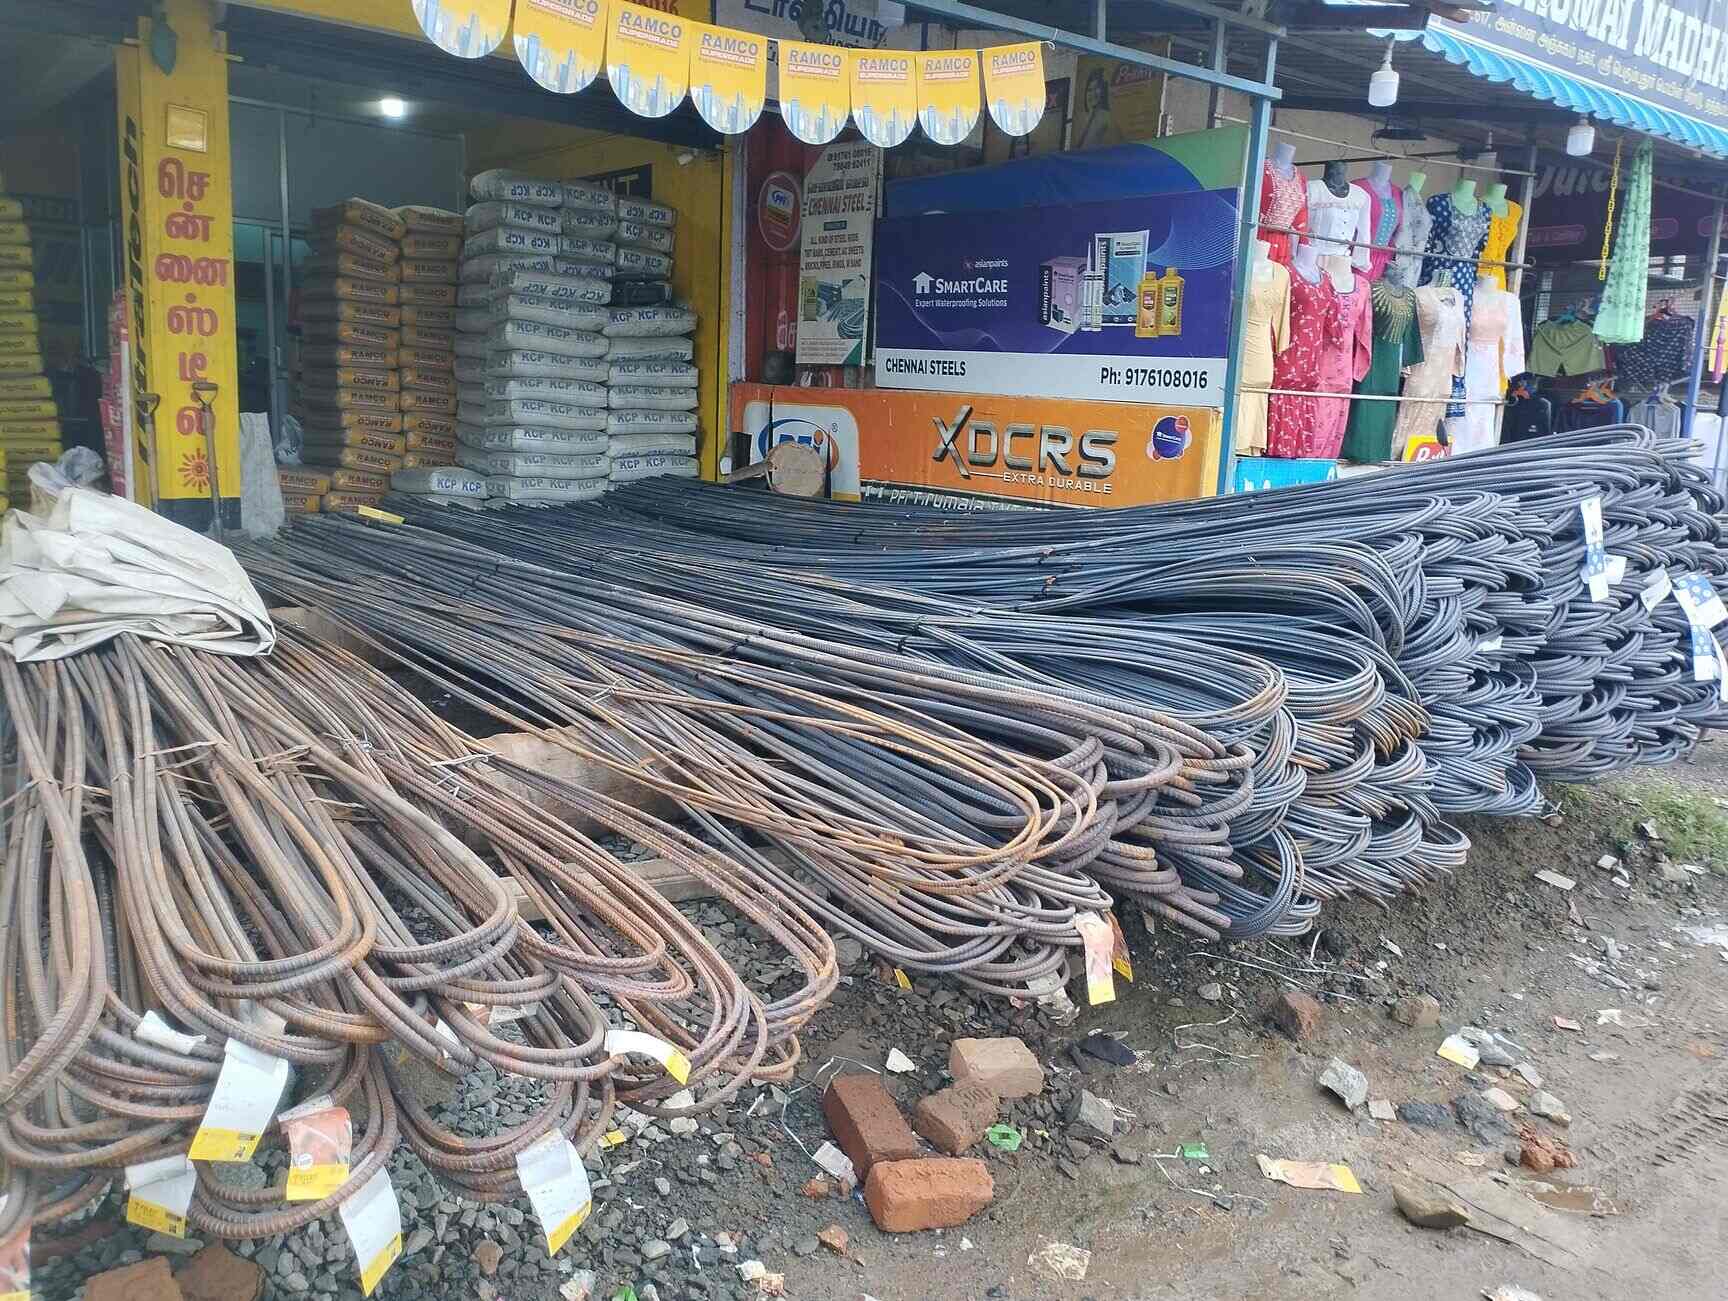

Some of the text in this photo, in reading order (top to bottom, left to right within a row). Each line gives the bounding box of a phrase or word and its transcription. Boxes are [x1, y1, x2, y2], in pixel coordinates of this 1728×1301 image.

[619, 10, 683, 39] RAMCO
[701, 33, 759, 57] RAMCO
[788, 50, 842, 68] RAMCO
[859, 58, 908, 72] RAMCO
[925, 58, 972, 71] RAMCO
[991, 50, 1035, 67] RAMCO
[511, 183, 556, 198] KCP KCP
[513, 208, 557, 226] KCP KCP
[505, 232, 551, 249] KCP KCP
[623, 252, 641, 265] KCP
[975, 259, 1008, 270] asianpaints
[522, 282, 605, 302] KCP KCP KCP
[1042, 269, 1051, 322] asianpaints
[915, 298, 1008, 310] Expert Waterproofing Solutions
[609, 310, 633, 323] KCP
[639, 309, 659, 321] KCP
[517, 320, 541, 334] KCP
[547, 326, 571, 338] KCP
[352, 351, 386, 363] RAMCO
[521, 352, 601, 369] KCP KCP KCP
[618, 361, 641, 374] KCP
[885, 359, 967, 378] CHENNAI STEELS
[1100, 366, 1209, 391] Ph: 9176108016
[549, 380, 572, 391] KCP
[352, 393, 386, 405] RAMCO
[416, 395, 449, 406] RAMCO
[521, 400, 545, 411] KCP
[358, 417, 394, 429] RAMCO
[617, 411, 639, 424] KCP
[361, 437, 395, 451] RAMCO
[420, 436, 453, 449] RAMCO
[357, 454, 392, 467] RAMCO
[619, 458, 641, 470] KCP
[646, 456, 667, 468] KCP
[281, 474, 317, 486] RAMCO
[348, 475, 384, 487] RAMCO
[437, 477, 481, 493] KCP KCP
[550, 479, 573, 490] KCP
[1003, 473, 1113, 495] EXTRA DURABLE
[285, 496, 309, 507] MCO
[340, 495, 378, 507] RAMCO
